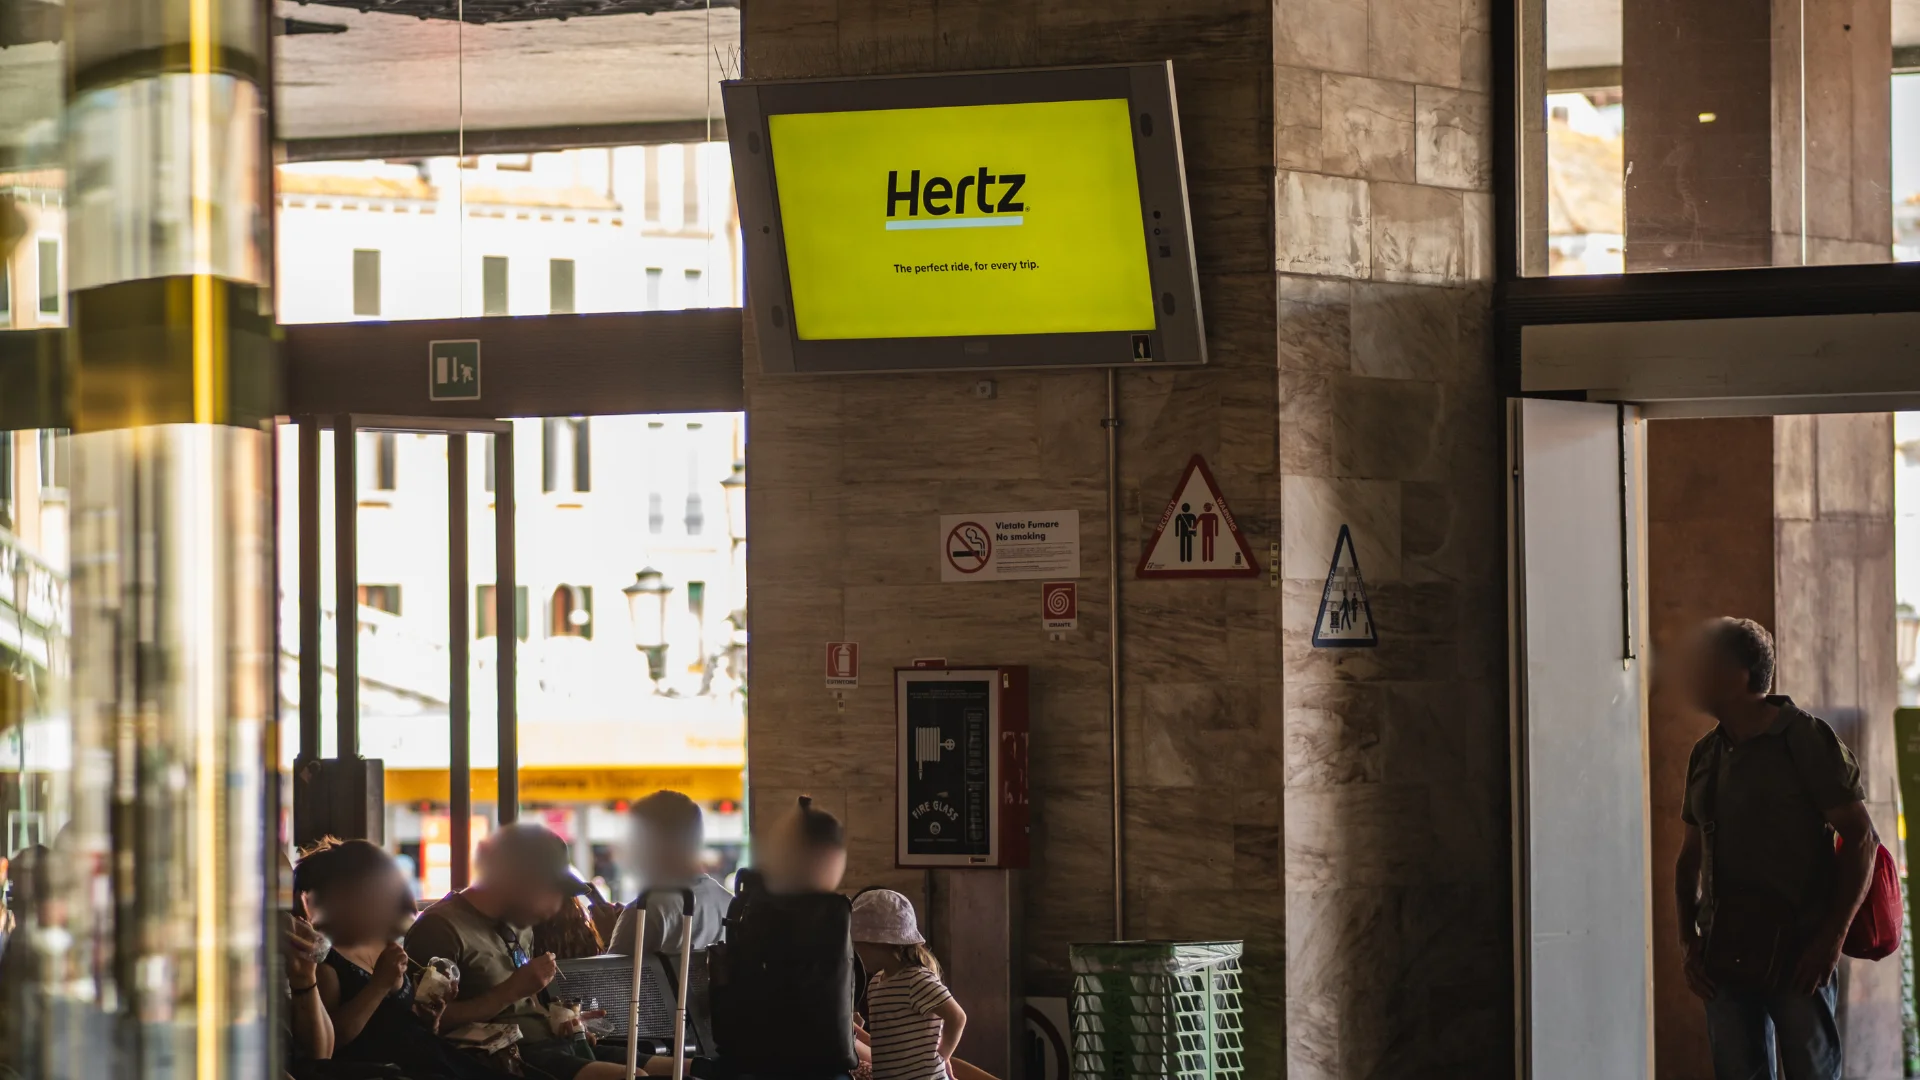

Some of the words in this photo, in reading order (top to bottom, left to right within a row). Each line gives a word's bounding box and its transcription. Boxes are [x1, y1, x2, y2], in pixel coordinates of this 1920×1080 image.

[886, 167, 1026, 217] Hertz
[894, 264, 912, 273] The
[915, 263, 949, 274] perfect
[951, 262, 973, 272] ride,
[974, 261, 988, 270] for
[991, 262, 1018, 272] every
[1020, 260, 1039, 271] trip.
[1157, 499, 1176, 533] SECURITY
[1216, 496, 1237, 532] WARNING
[995, 521, 1026, 530] Vietato
[1027, 520, 1060, 529] Fumare
[996, 533, 1008, 541] No
[1010, 532, 1046, 541] smoking
[911, 801, 931, 819] FIRE
[932, 800, 959, 821] GLASS
